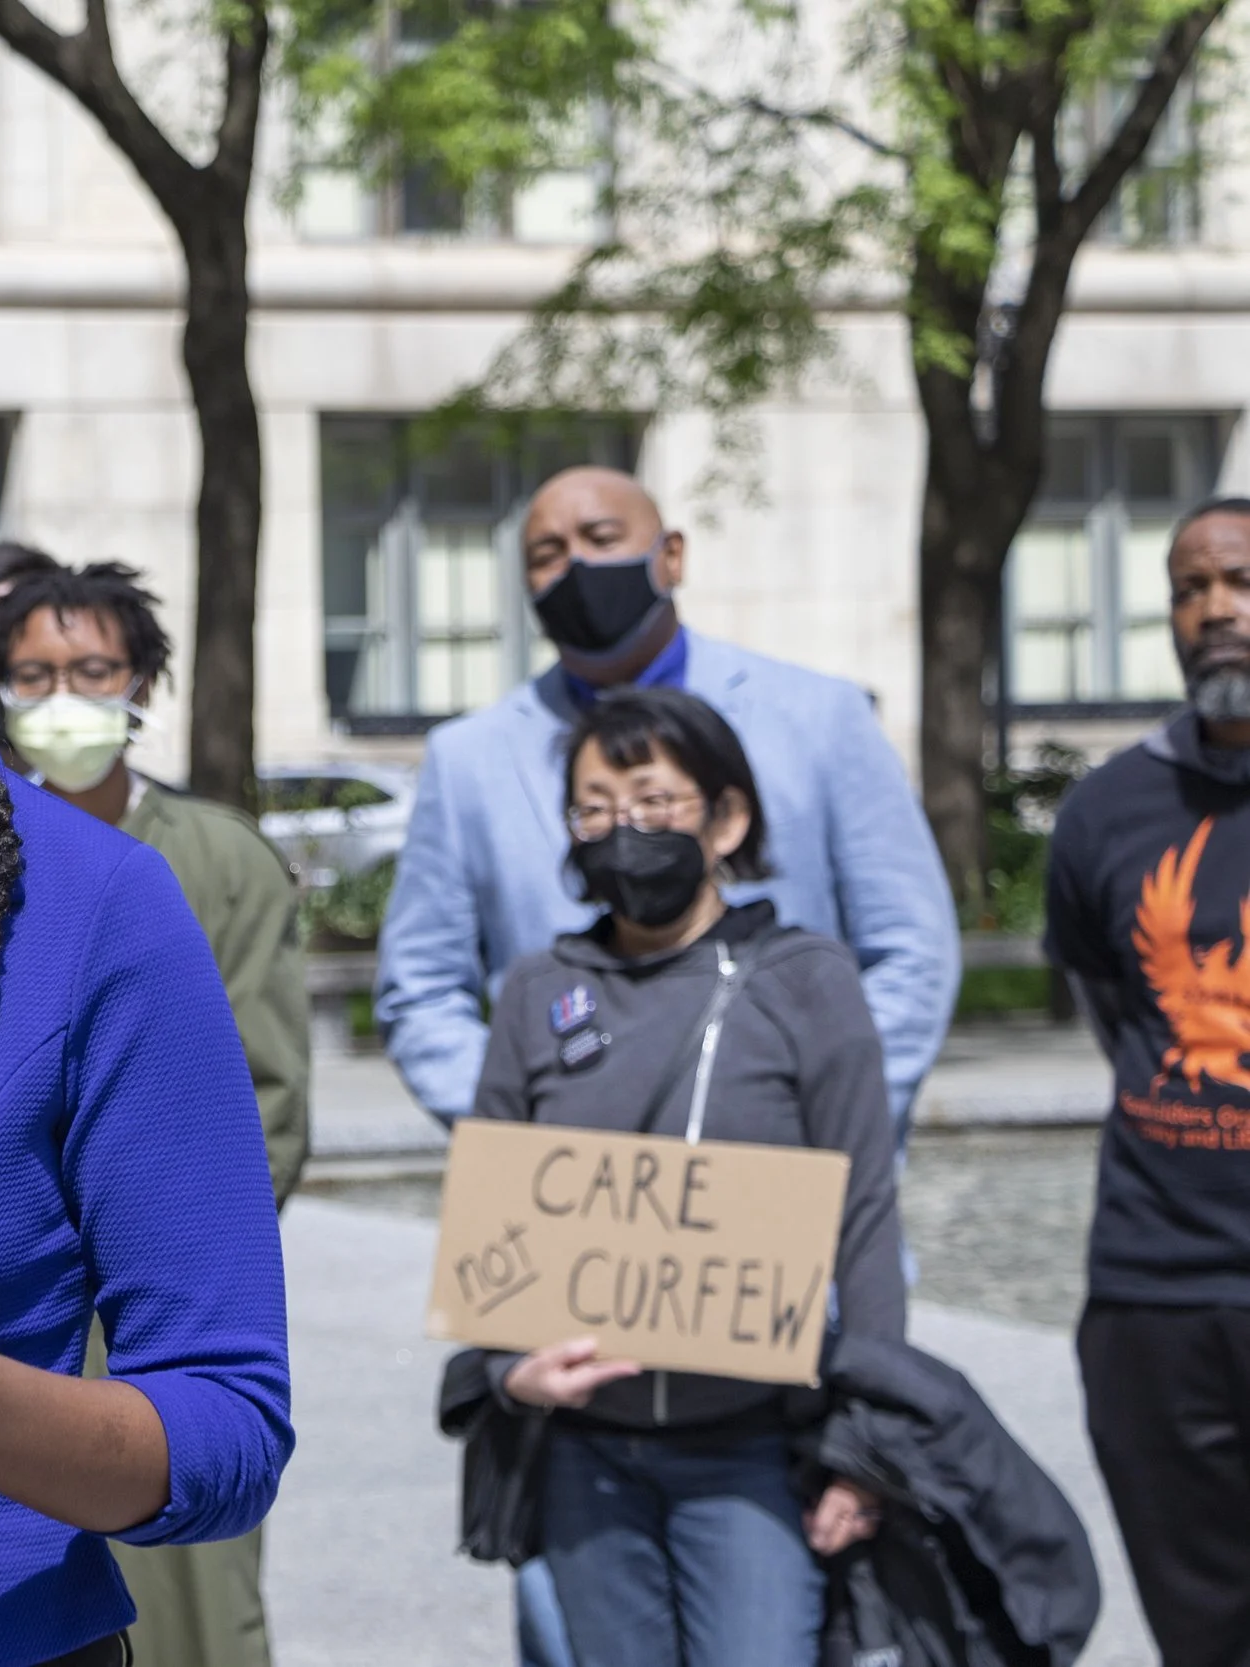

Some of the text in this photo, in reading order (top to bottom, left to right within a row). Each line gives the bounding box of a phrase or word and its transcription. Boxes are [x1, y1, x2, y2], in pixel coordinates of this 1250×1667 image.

[531, 1146, 718, 1232] CARE
[453, 1219, 823, 1352] not CURFEW
